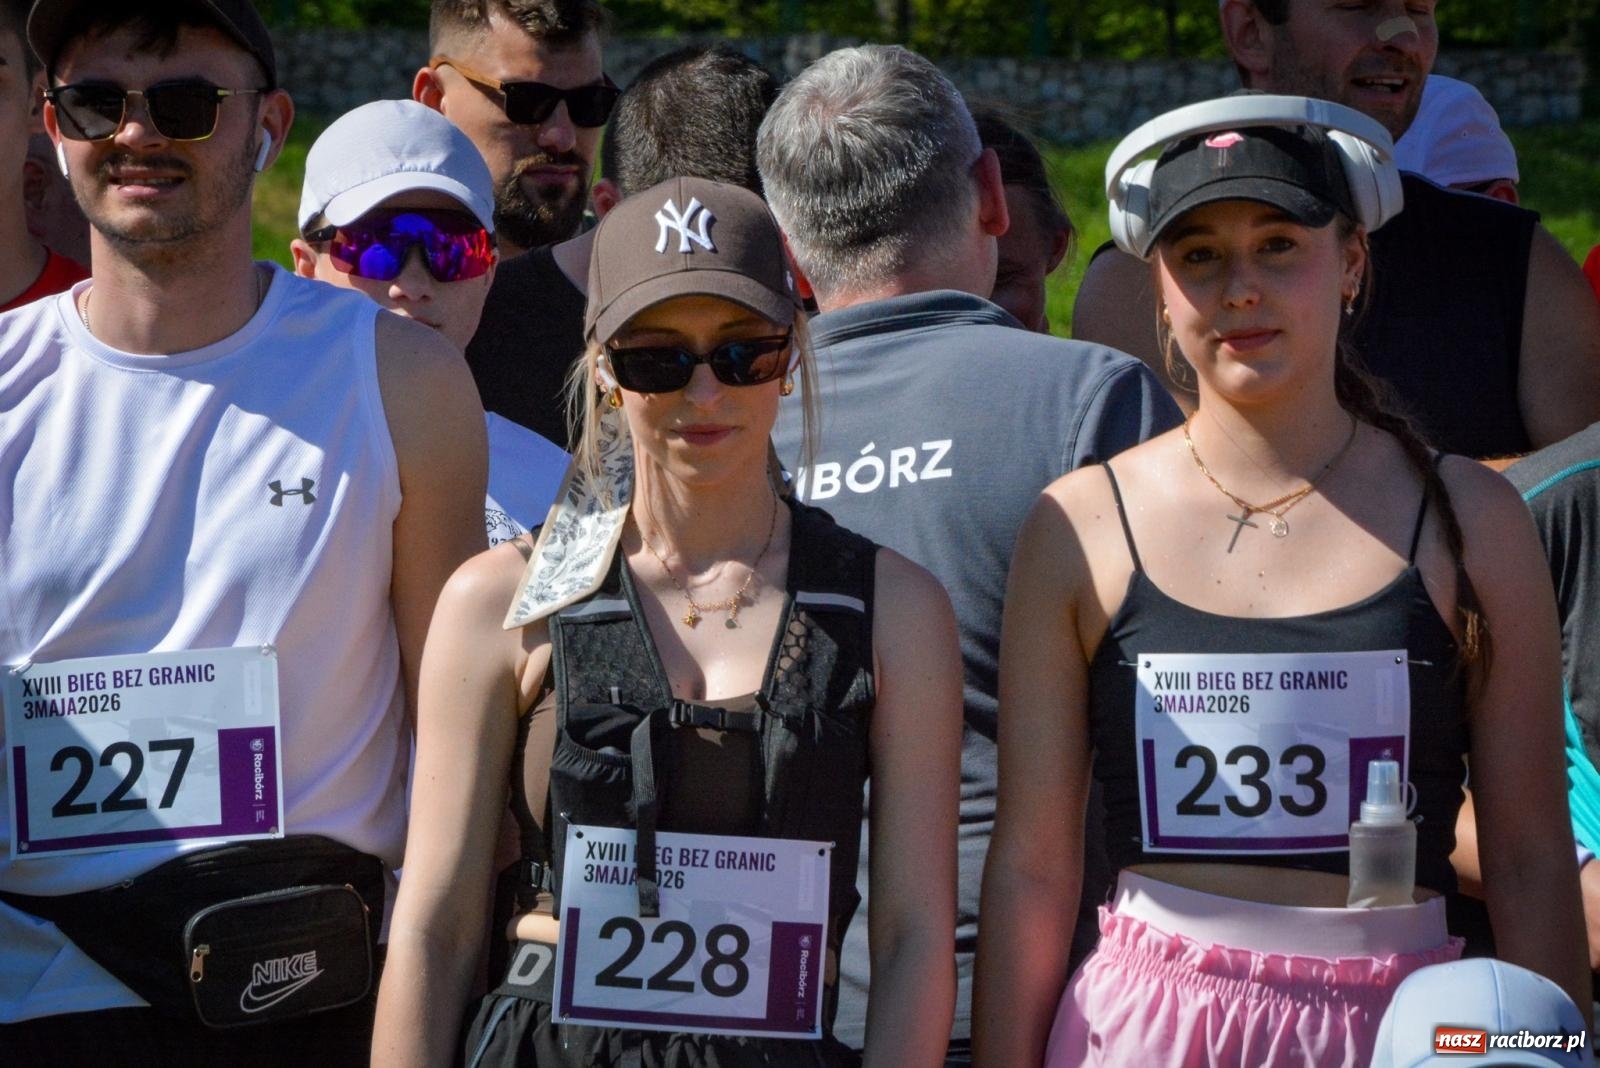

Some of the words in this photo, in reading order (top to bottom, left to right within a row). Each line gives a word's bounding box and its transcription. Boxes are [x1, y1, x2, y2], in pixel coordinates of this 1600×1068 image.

[781, 439, 953, 502] IBÓRZ
[22, 677, 62, 698] XVIII
[67, 672, 107, 693] BIEG
[113, 668, 143, 689] BEZ
[149, 663, 216, 686] GRANIC
[1154, 671, 1191, 690] XVIII
[1196, 671, 1236, 690] BIEG
[1242, 671, 1274, 690] BEZ
[1280, 670, 1348, 690] GRANIC
[24, 693, 121, 720] 3MAJA2026
[1154, 695, 1250, 714] 3MAJA2026
[50, 737, 195, 818] 227
[253, 753, 264, 800] Racibórz
[1174, 743, 1328, 818] 233
[585, 841, 627, 862] XVIII
[679, 848, 709, 868] BEZ
[714, 849, 776, 872] GRANIC
[584, 863, 685, 889] 3MAJA26
[252, 950, 318, 986] NIKE
[595, 916, 750, 998] 228
